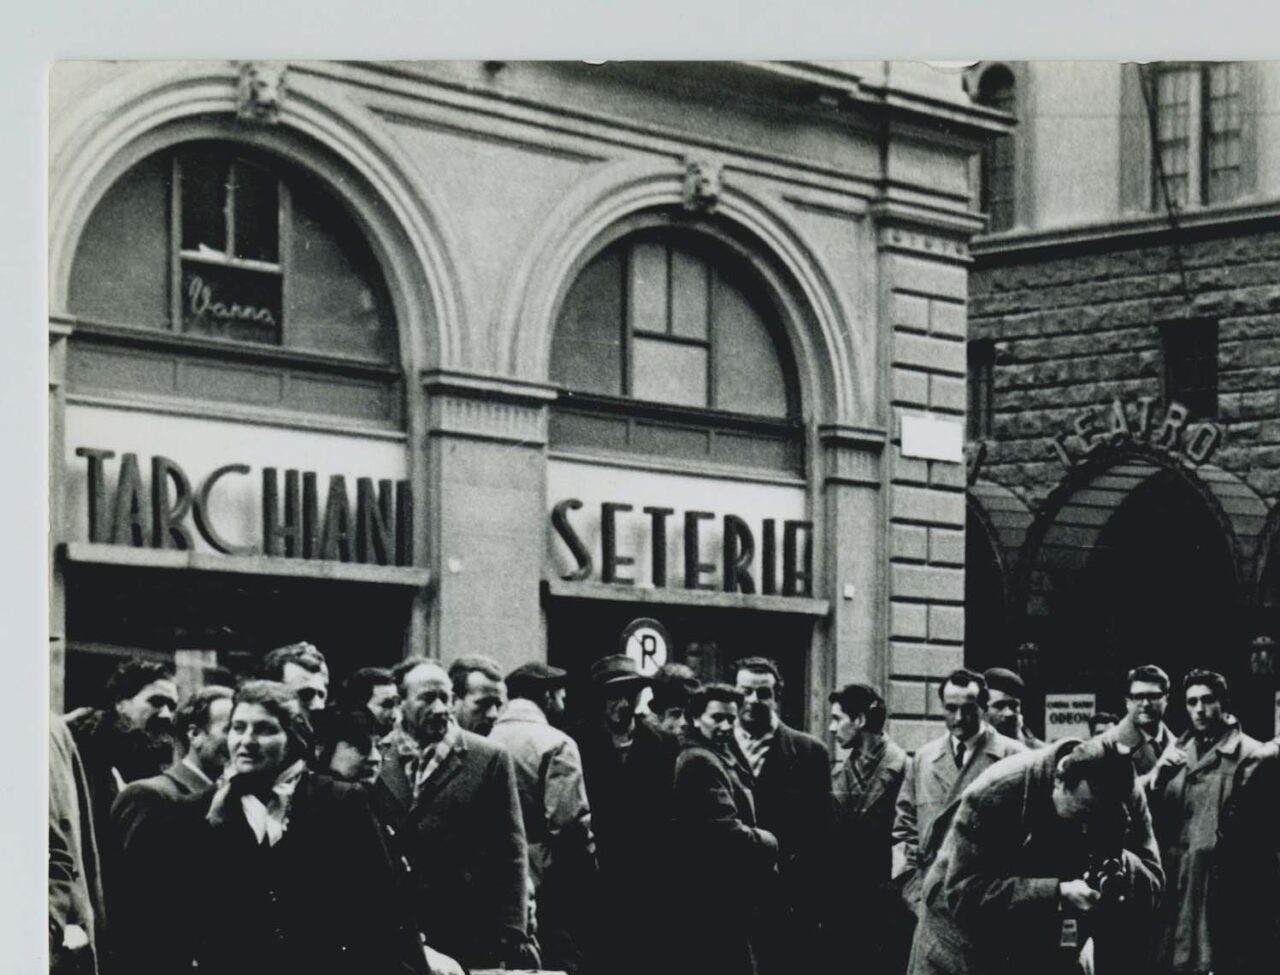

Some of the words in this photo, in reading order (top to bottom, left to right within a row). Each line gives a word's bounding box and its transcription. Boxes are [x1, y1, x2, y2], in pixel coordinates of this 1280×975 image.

[1053, 396, 1220, 466] TEATRO
[75, 446, 413, 567] TARCHIANI
[551, 498, 814, 598] SETERIE
